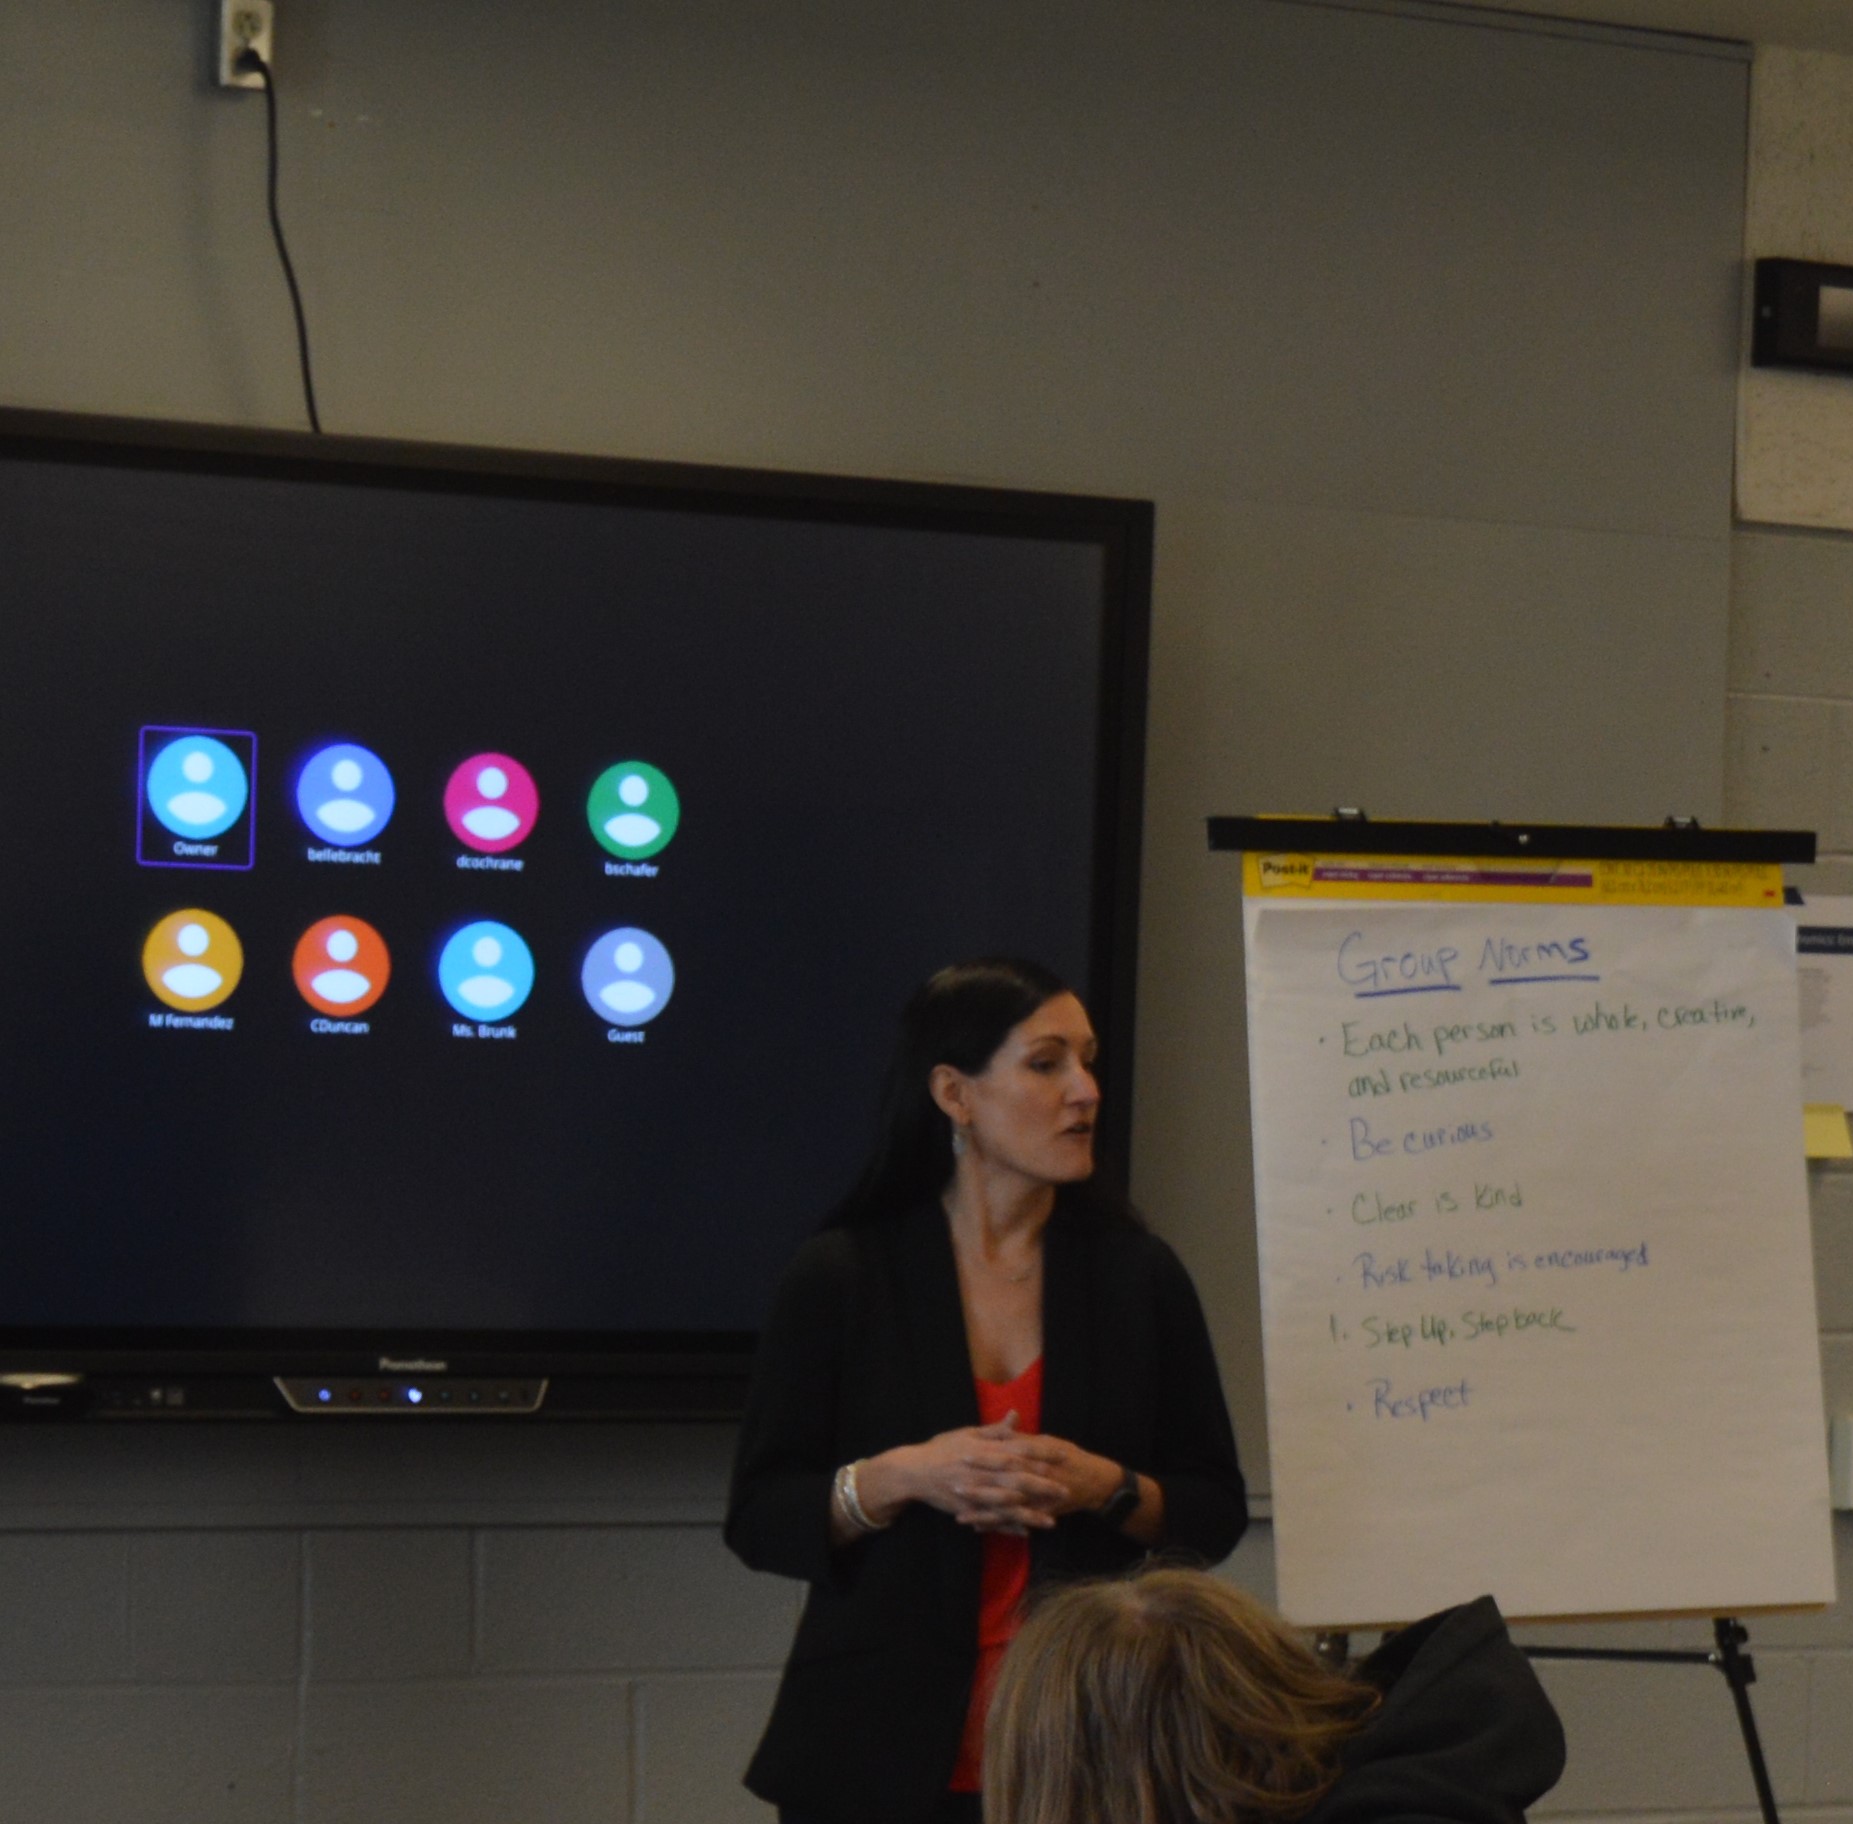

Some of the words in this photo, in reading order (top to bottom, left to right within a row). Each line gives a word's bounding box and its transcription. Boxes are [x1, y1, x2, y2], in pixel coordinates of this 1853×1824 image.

[173, 842, 219, 856] Owner
[1337, 931, 1459, 988] Group
[1478, 936, 1591, 972] Norms
[607, 1029, 646, 1044] Guest
[1341, 1021, 1424, 1057] Each
[1433, 1019, 1517, 1055] person
[1531, 1014, 1557, 1034] is
[1348, 1069, 1390, 1099] and
[1399, 1057, 1520, 1093] resourceful
[1351, 1116, 1393, 1161] Be
[1402, 1121, 1494, 1154] curious
[1351, 1191, 1418, 1225] Clear
[1436, 1191, 1458, 1212] is
[1352, 1251, 1411, 1289] Risk
[1507, 1250, 1528, 1269] is
[1534, 1241, 1650, 1272] encouraged
[1362, 1315, 1412, 1349] Step
[1366, 1376, 1473, 1422] Respect
